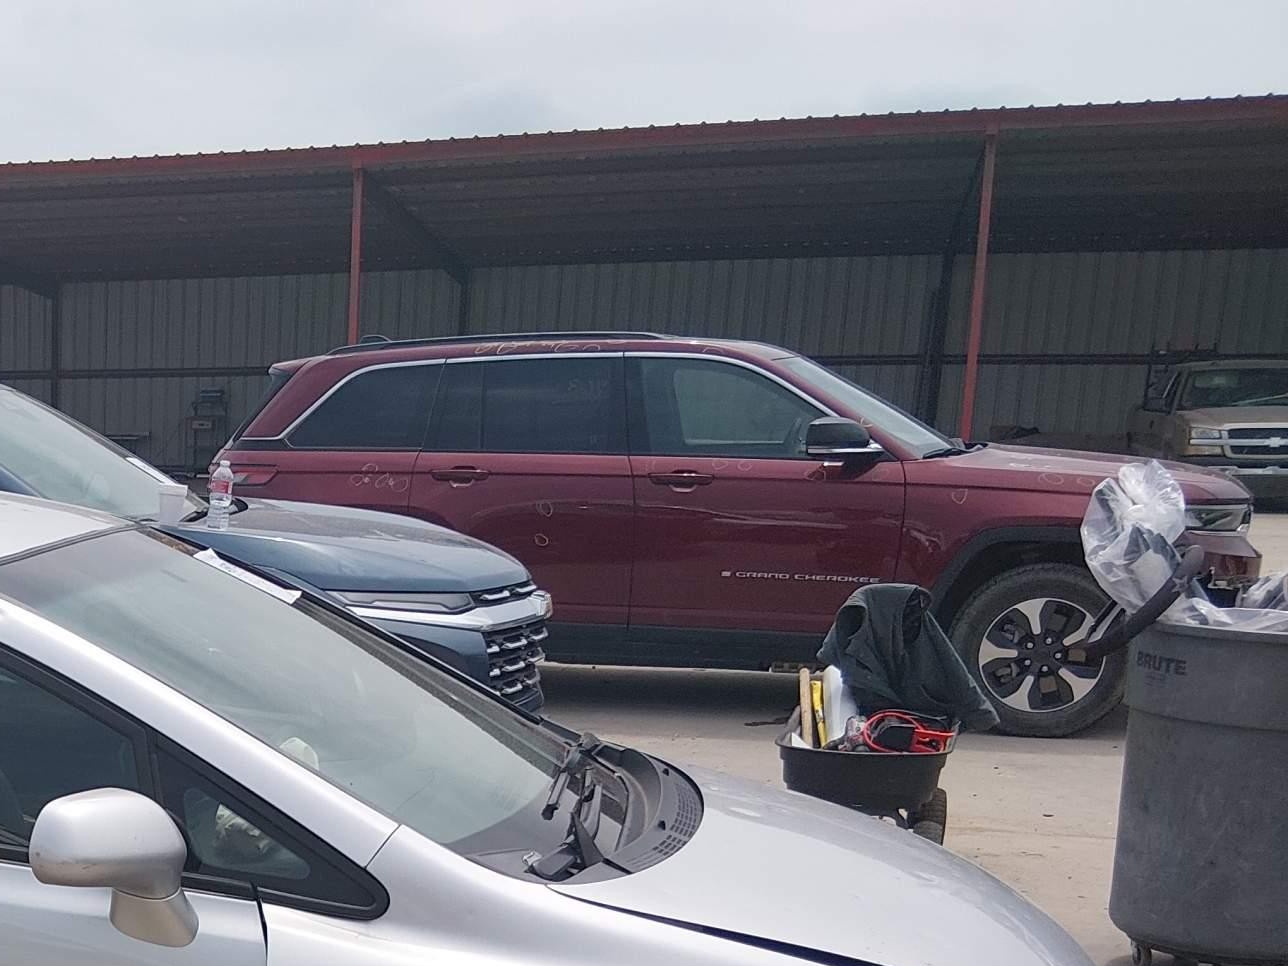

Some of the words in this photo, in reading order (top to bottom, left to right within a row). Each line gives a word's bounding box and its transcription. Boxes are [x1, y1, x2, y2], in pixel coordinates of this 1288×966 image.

[736, 571, 790, 580] GRAND
[794, 573, 881, 583] CHEROKEE
[1137, 650, 1188, 676] BRUTE
